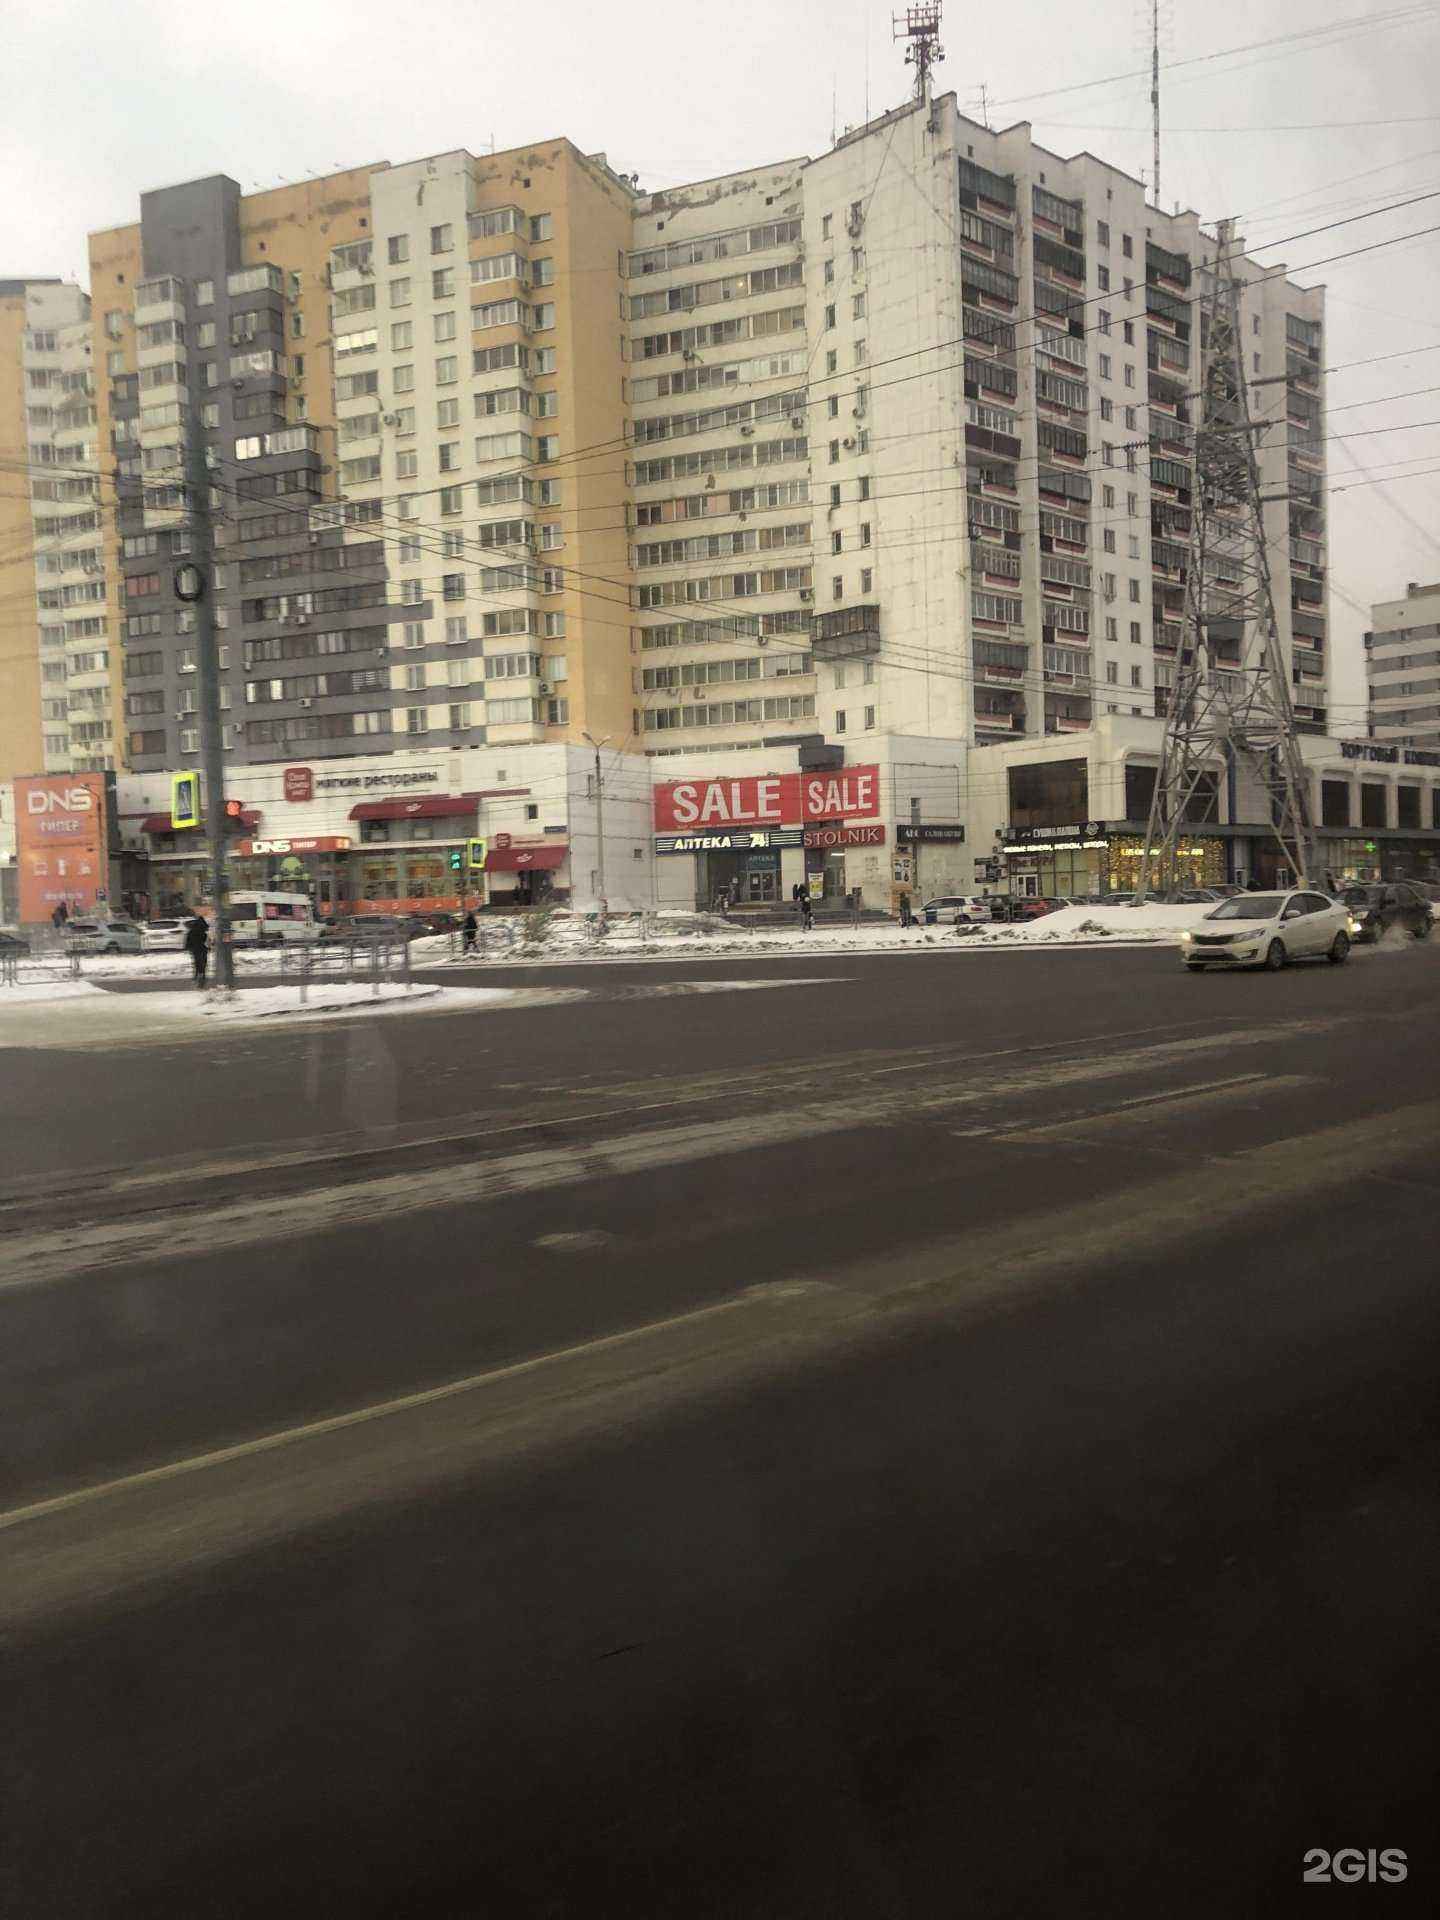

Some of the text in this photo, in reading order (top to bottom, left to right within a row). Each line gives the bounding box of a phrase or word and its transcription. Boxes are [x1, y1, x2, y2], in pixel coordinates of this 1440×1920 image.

[363, 771, 438, 790] рестораны
[28, 788, 92, 816] DNS
[672, 779, 782, 824] SALE
[808, 775, 873, 815] SALE
[674, 836, 732, 850] АПТЕКА
[803, 828, 880, 846] STOLNIK
[252, 840, 292, 854] DNS
